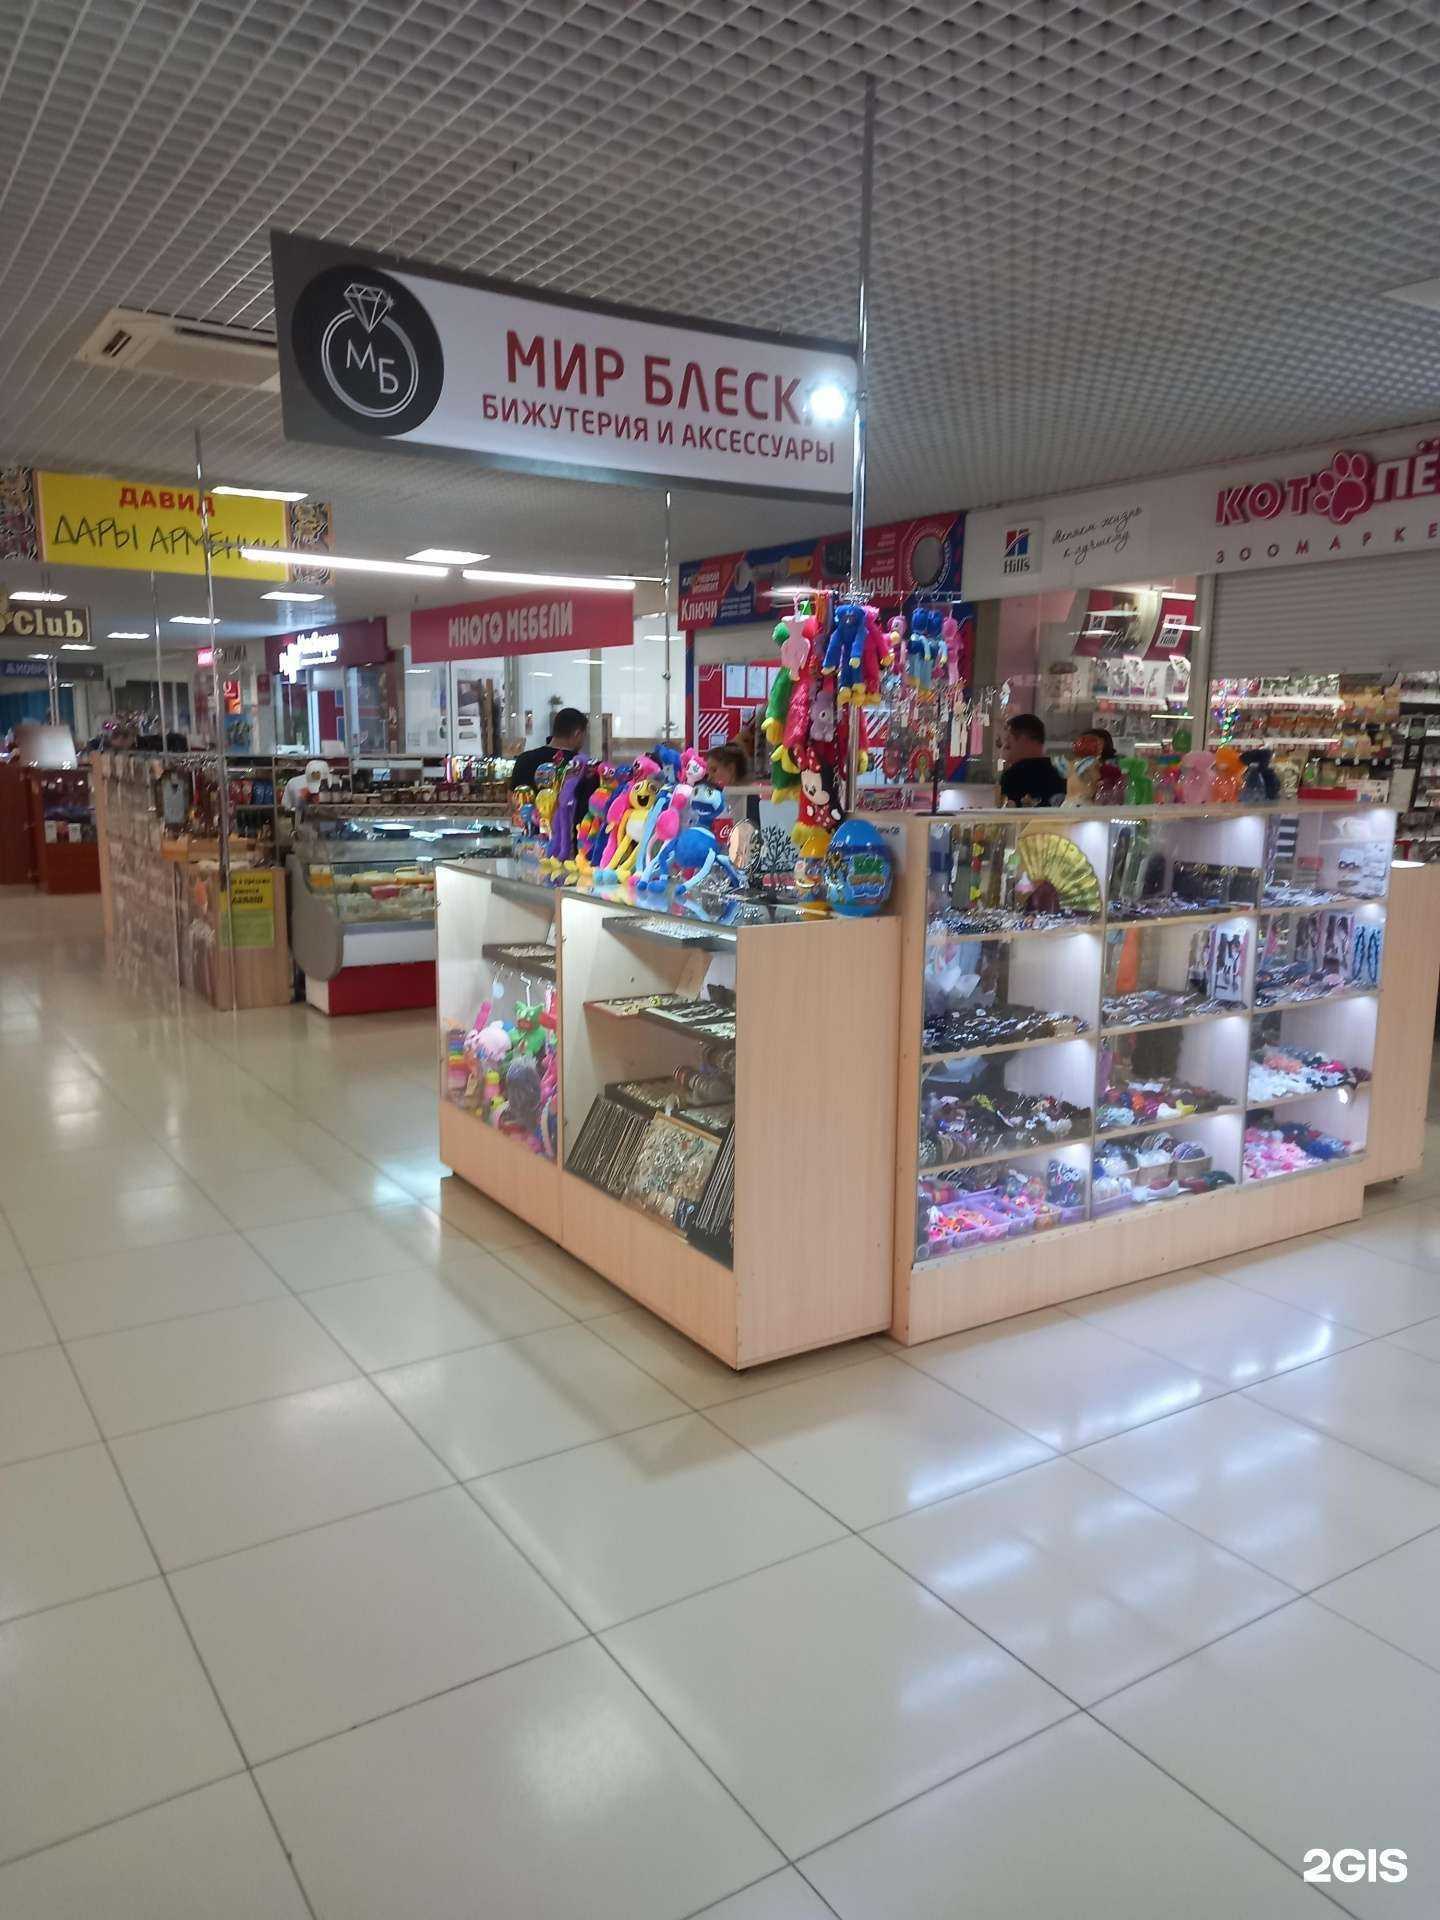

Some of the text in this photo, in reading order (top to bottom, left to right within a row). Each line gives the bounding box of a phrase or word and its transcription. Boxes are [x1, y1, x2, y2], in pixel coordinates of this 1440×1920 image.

[505, 329, 840, 428] МИР БЛЕСК
[482, 393, 835, 465] БИЖУТЕРИЯ И АКСЕССУАРЫ
[118, 487, 216, 517] ДАВИД
[53, 513, 139, 550] ДАРЫ
[13, 607, 84, 639] Club
[447, 600, 574, 648] МНОГО МЕБЕЛИ
[681, 598, 719, 623] Ключи
